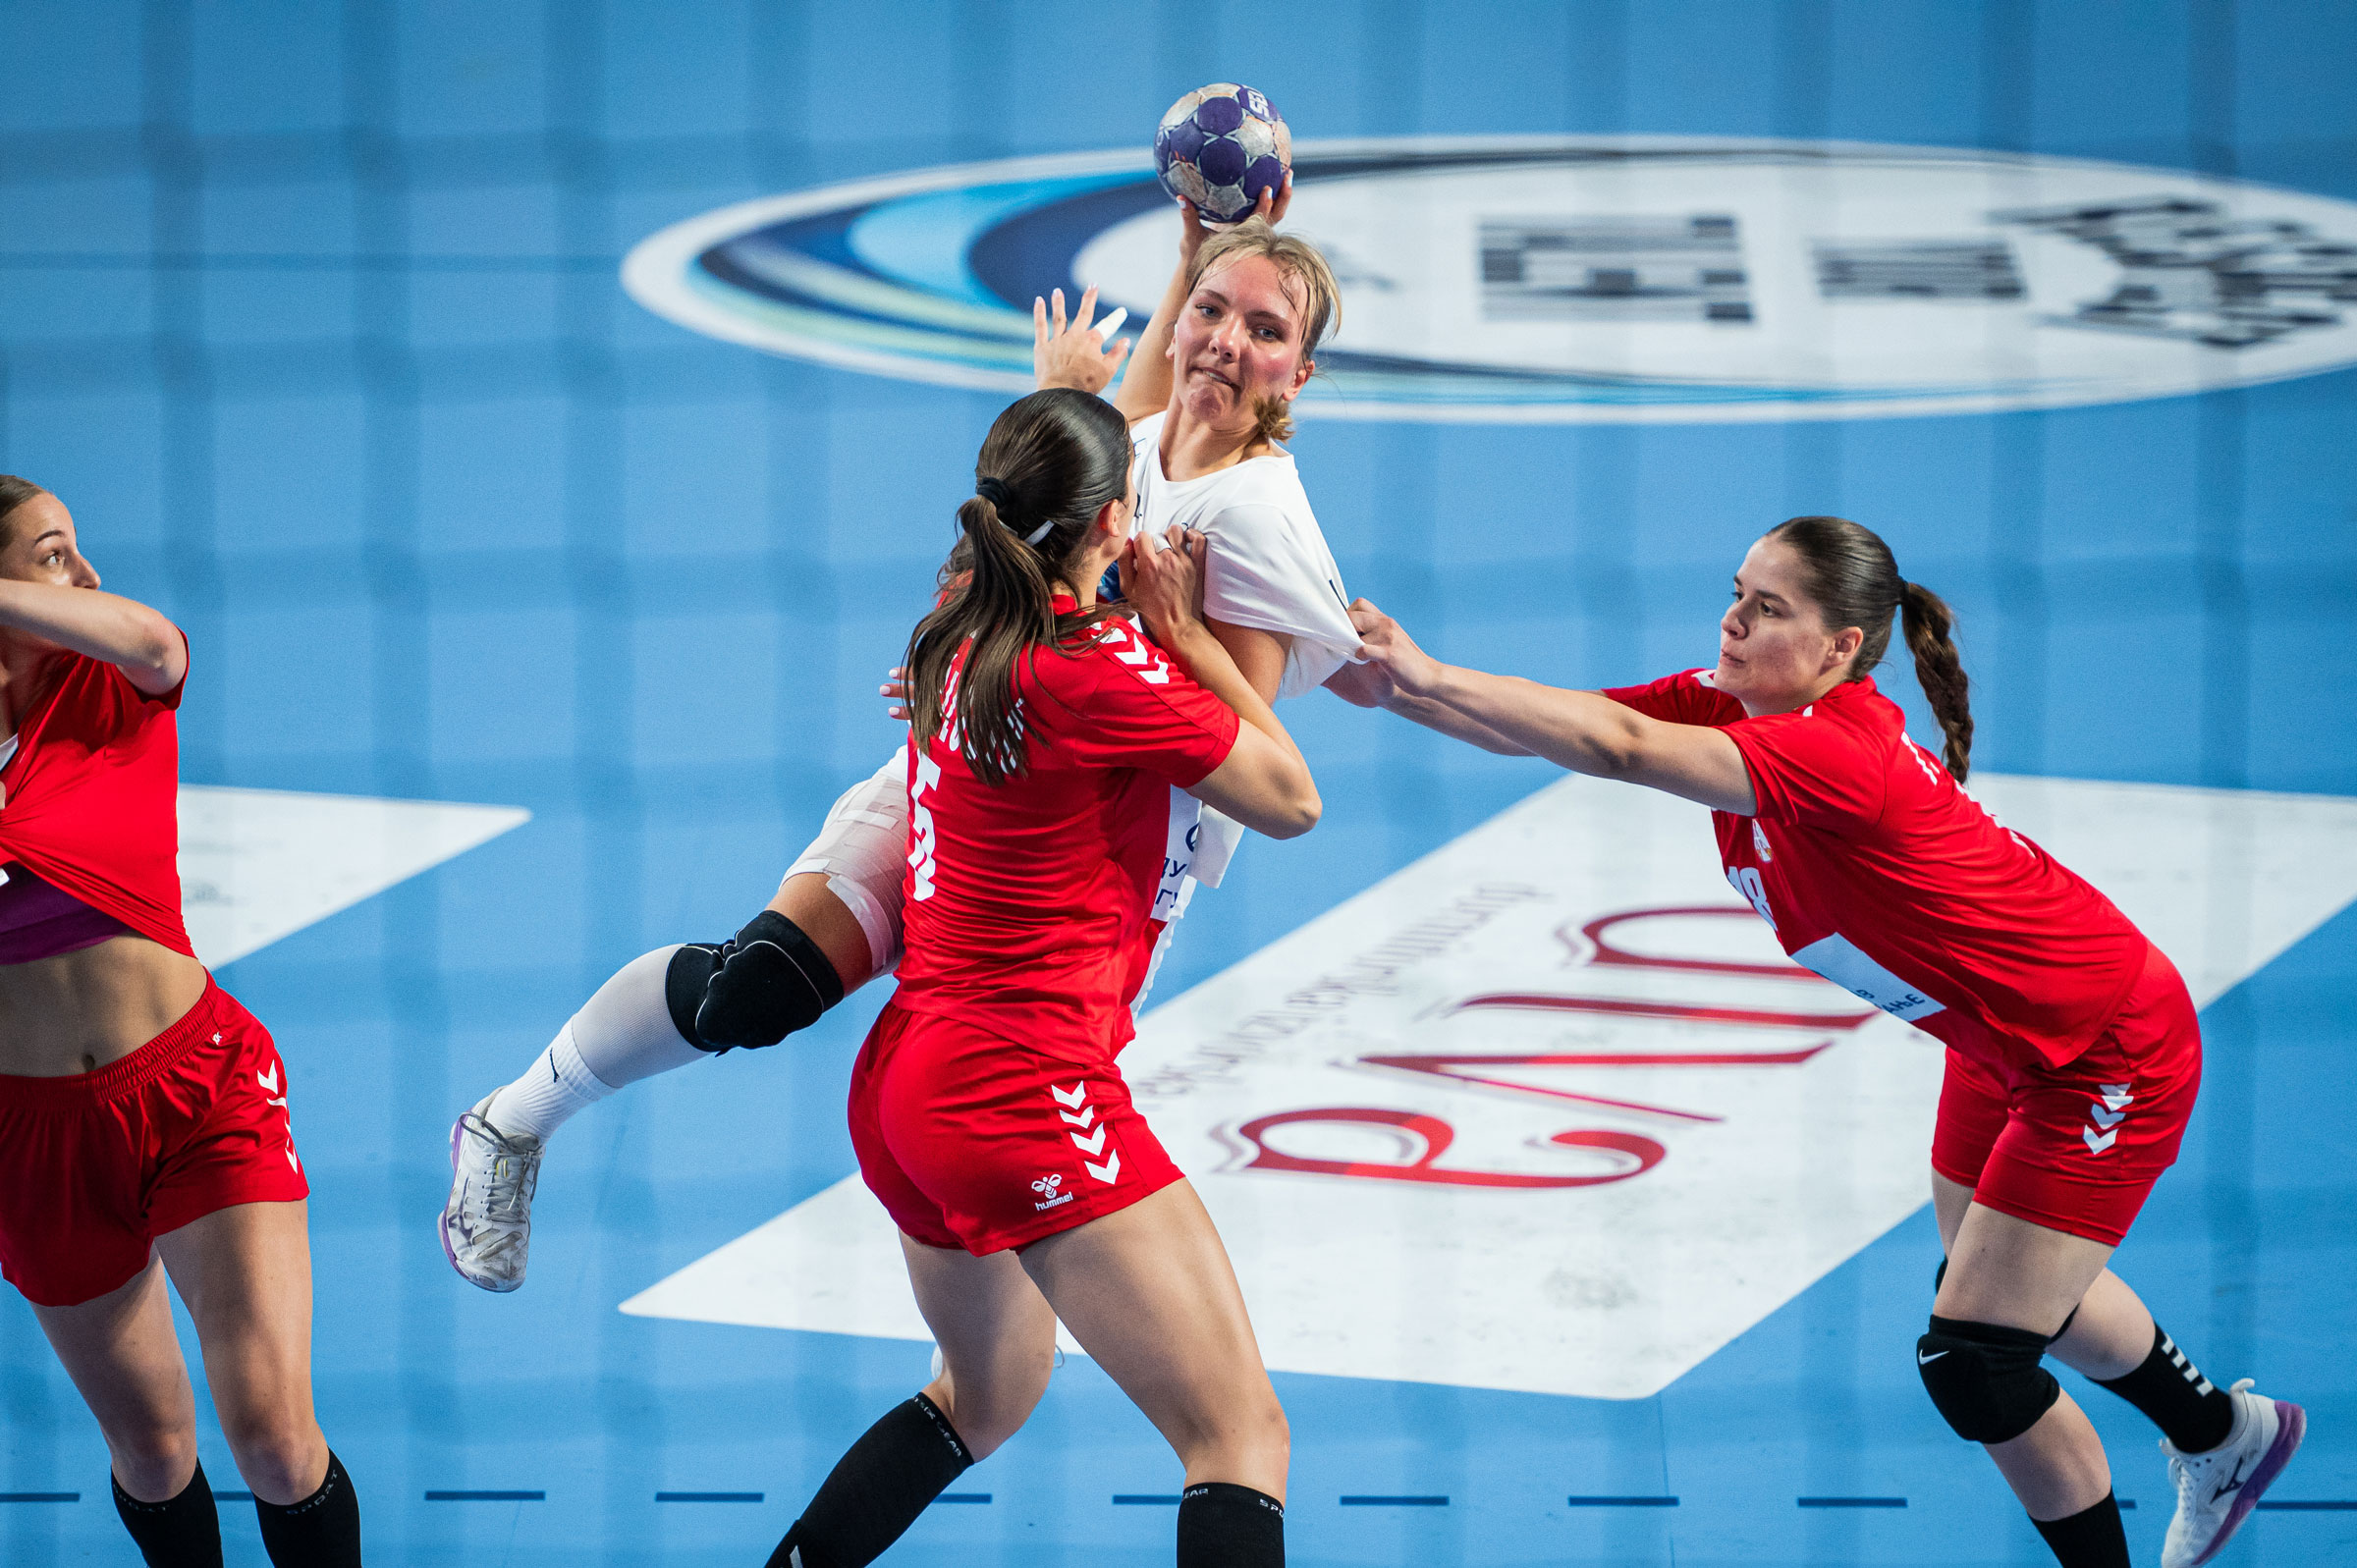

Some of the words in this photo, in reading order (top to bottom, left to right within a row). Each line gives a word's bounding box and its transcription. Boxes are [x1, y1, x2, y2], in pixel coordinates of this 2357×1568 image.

[1247, 87, 1270, 119] SEL
[1034, 1190, 1073, 1212] hummel
[1183, 1487, 1209, 1499] EAR
[1259, 1498, 1285, 1519] SPO
